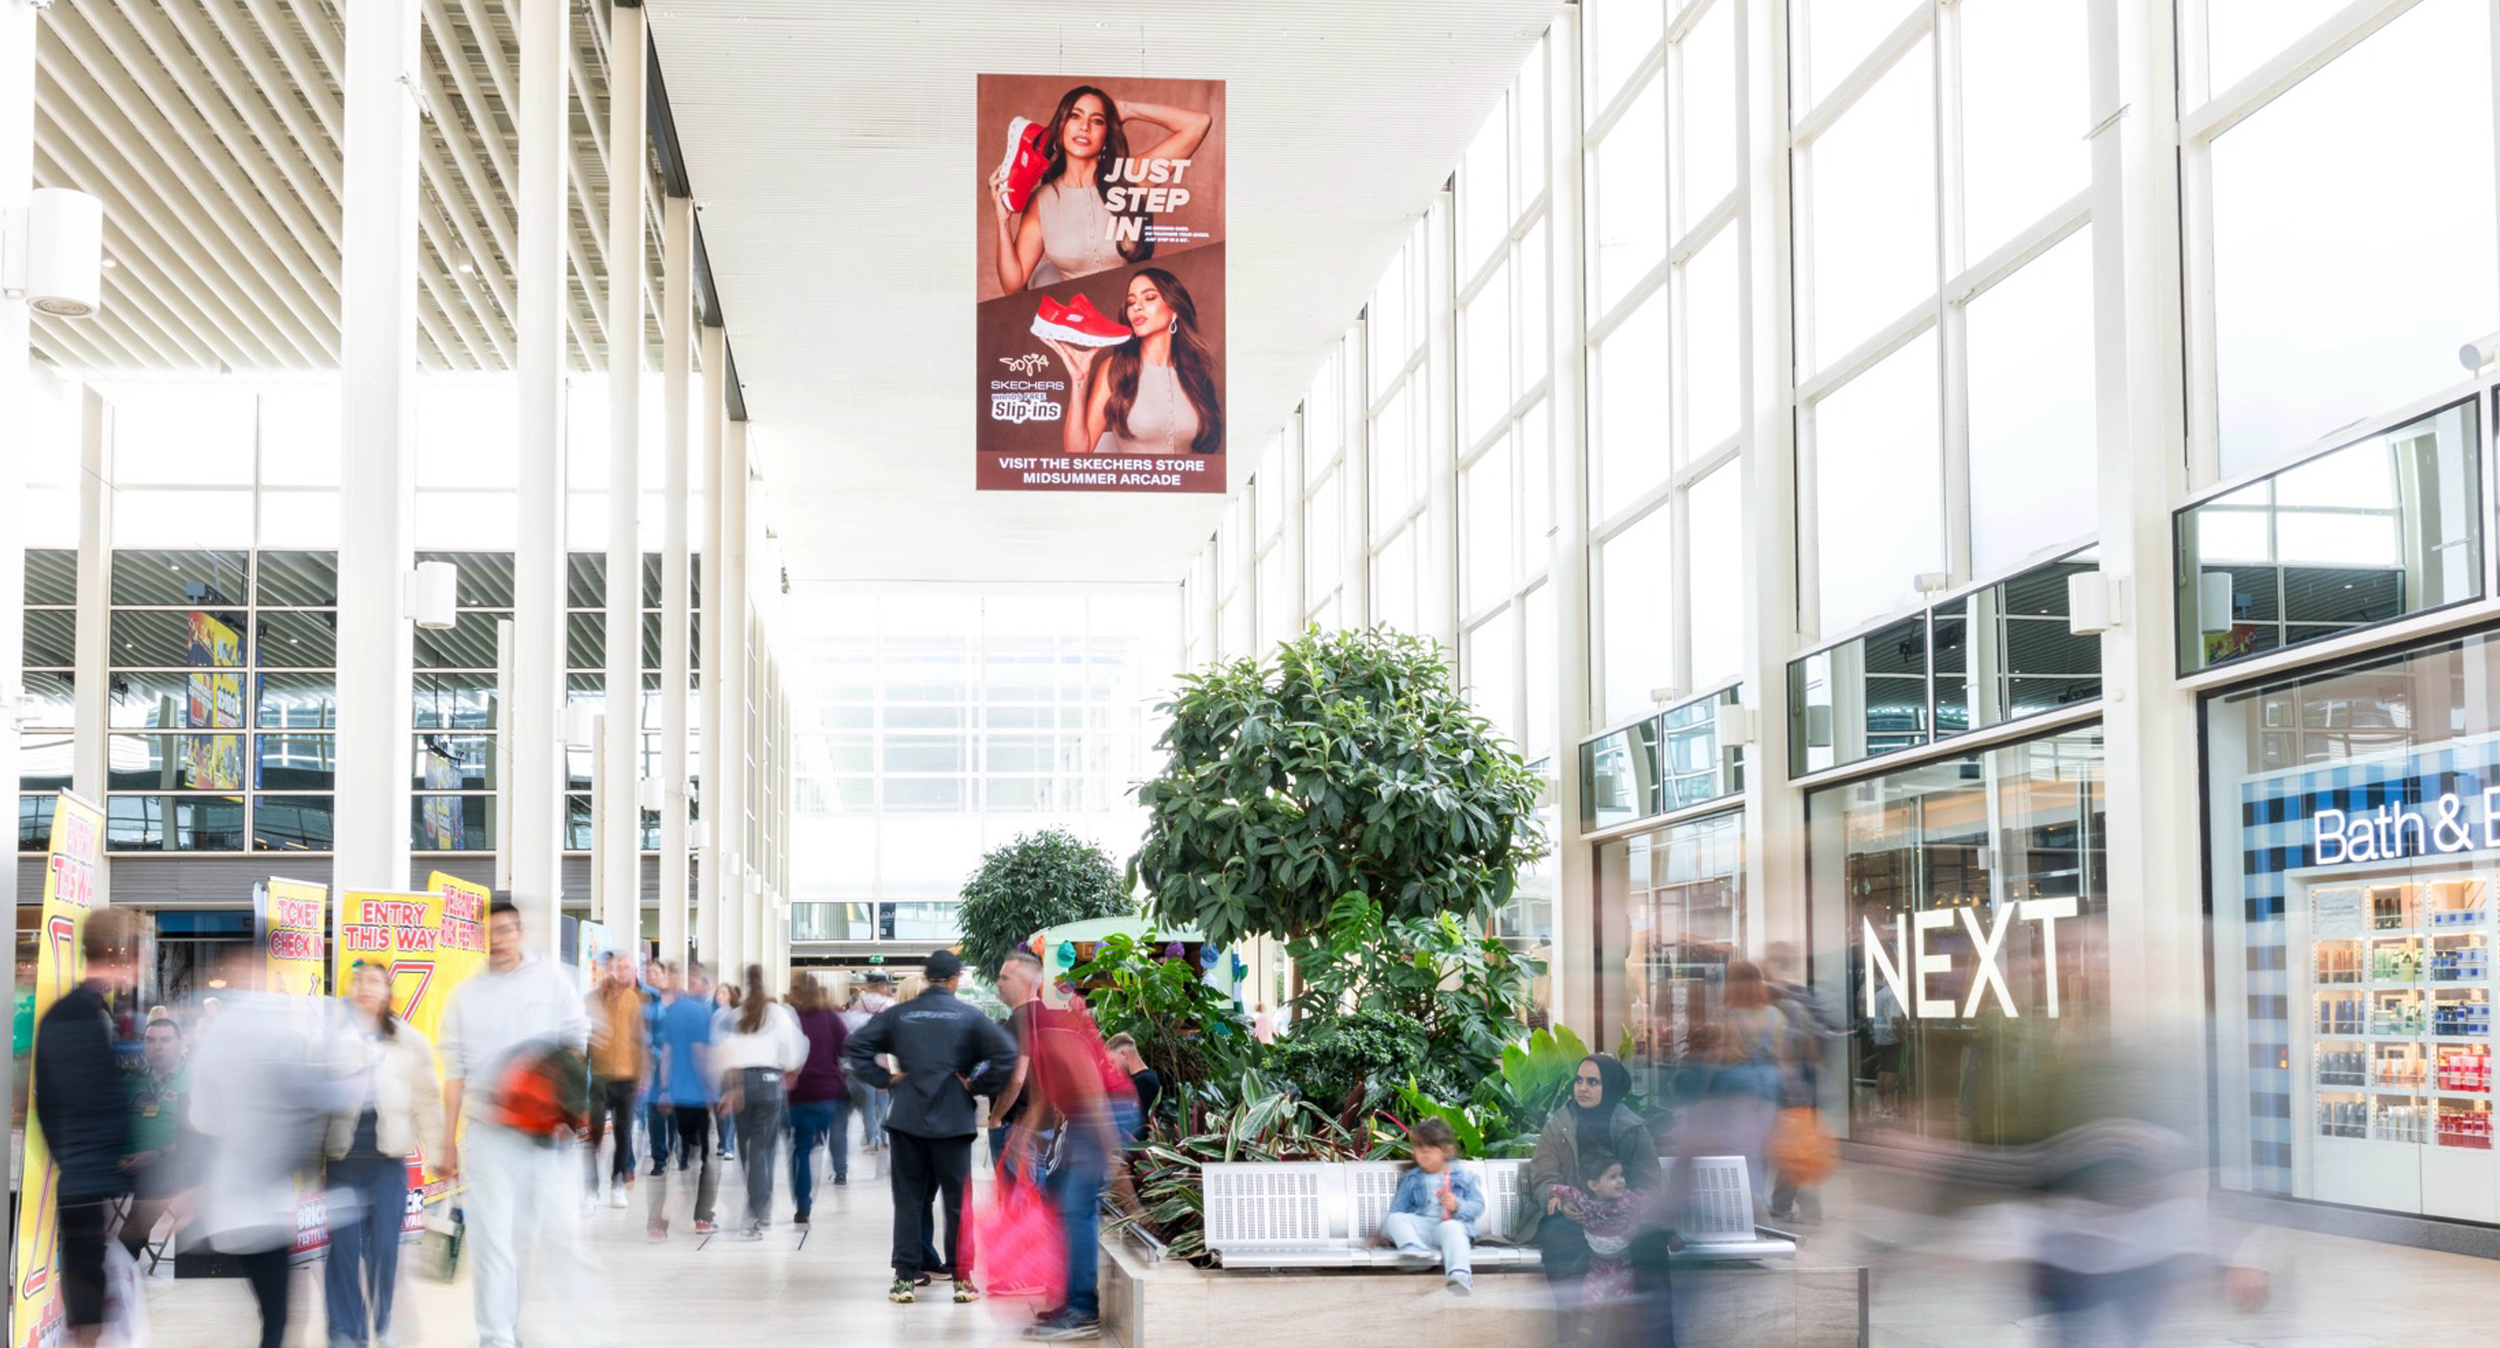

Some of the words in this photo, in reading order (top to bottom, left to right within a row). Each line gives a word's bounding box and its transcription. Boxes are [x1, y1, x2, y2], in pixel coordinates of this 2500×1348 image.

[1104, 157, 1192, 184] JUST
[1104, 186, 1191, 213] STEP
[991, 380, 1064, 391] SKECHERS
[994, 400, 1060, 421] Slip-ins
[999, 457, 1037, 470] VISIT
[1040, 457, 1070, 470] THE
[1072, 458, 1153, 471] SKECHERS
[1156, 459, 1204, 472] STORE
[1023, 472, 1117, 485] MIDSUMMER
[1120, 473, 1181, 486] ARCADE
[2314, 800, 2426, 865] Bath
[2433, 792, 2474, 852] &
[277, 897, 321, 930] TICKET
[361, 899, 428, 928] ENTRY
[269, 929, 311, 960] CHECK
[343, 926, 392, 951] THIS
[394, 927, 439, 952] WAY
[1863, 896, 2077, 1020] NEXT
